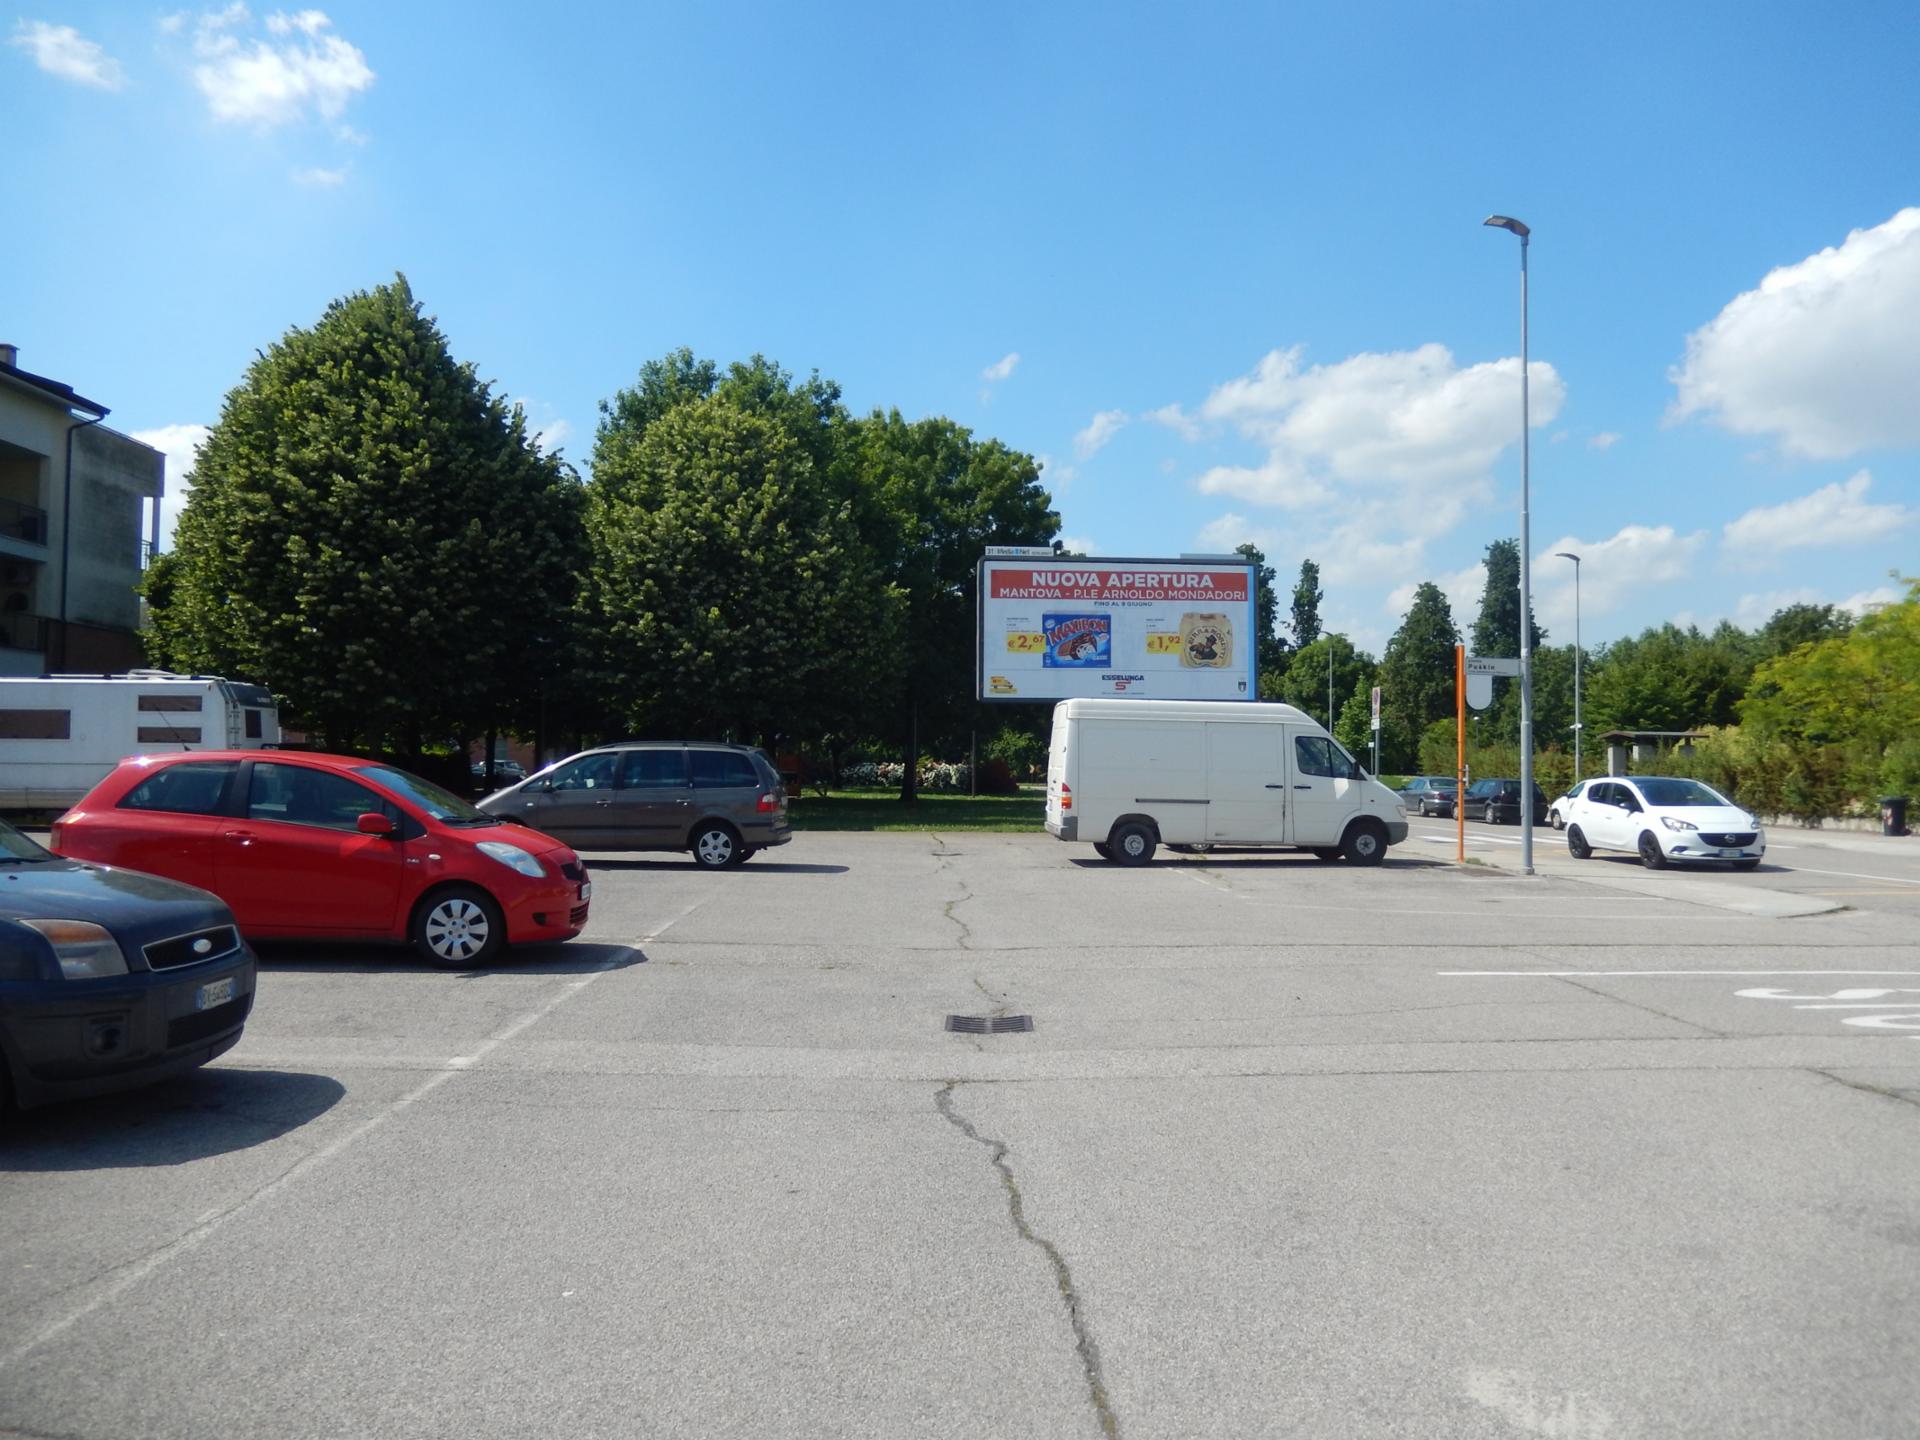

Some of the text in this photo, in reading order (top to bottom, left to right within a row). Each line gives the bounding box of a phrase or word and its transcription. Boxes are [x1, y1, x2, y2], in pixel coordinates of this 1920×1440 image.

[1032, 572, 1214, 588] NUOVA APERTURA
[1000, 588, 1062, 598] MANTOVA
[1073, 589, 1098, 599] P.LE
[1102, 589, 1165, 600] ARNOLDO
[1168, 590, 1245, 601] MONDADORI
